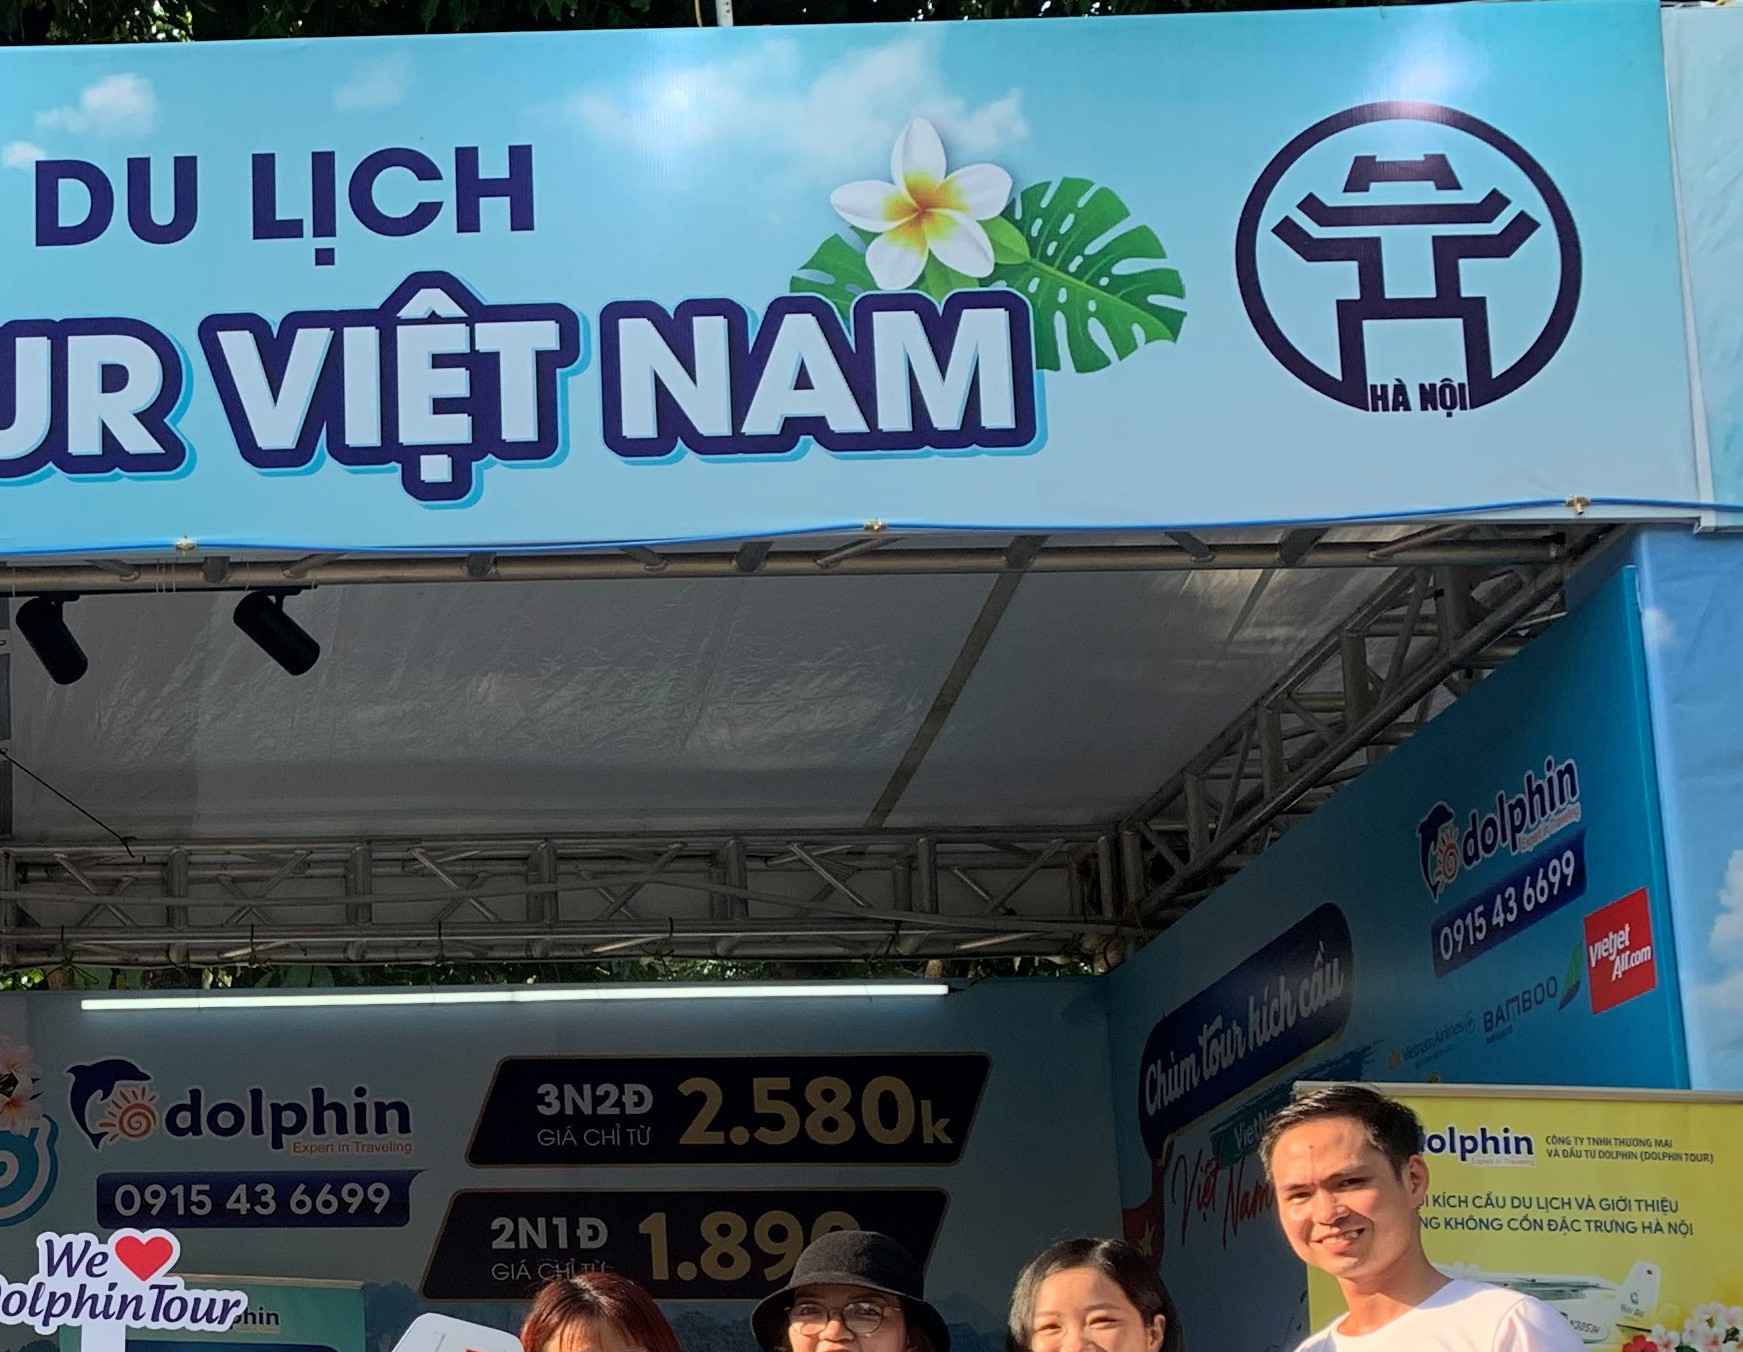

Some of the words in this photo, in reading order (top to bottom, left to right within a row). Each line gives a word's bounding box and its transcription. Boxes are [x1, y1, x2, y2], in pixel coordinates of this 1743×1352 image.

[35, 156, 198, 247] DU
[252, 145, 535, 266] LỊCH
[208, 279, 569, 492] VIỆT
[610, 300, 1025, 446] NAM
[1370, 378, 1412, 414] HÀ
[1420, 380, 1468, 418] NỘI
[1463, 758, 1578, 867] dolphin
[1440, 904, 1487, 960] 0915
[1492, 887, 1518, 928] 43
[1523, 850, 1575, 912] 6699
[1198, 1015, 1246, 1081] tour
[1248, 975, 1297, 1052] kích
[165, 1086, 411, 1150] dolphin
[536, 1083, 654, 1116] 3N2Đ
[677, 1074, 954, 1147] 2.580k
[292, 1141, 335, 1155] Expert
[337, 1142, 349, 1154] in
[355, 1141, 413, 1156] Traveling
[536, 1125, 578, 1148] GIÁ
[583, 1122, 621, 1147] CHỈ
[624, 1124, 652, 1147] TỪ
[1421, 1126, 1534, 1161] olphin
[1546, 1134, 1571, 1146] CÔNG
[1574, 1136, 1584, 1146] TY
[1587, 1136, 1612, 1147] TNHH
[1598, 1150, 1638, 1160] DOLPHIN
[1640, 1151, 1683, 1163] (DOLPHIN
[1684, 1153, 1715, 1164] TOUR)
[115, 1184, 212, 1217] 0915
[226, 1183, 276, 1216] 43
[290, 1182, 391, 1215] 6699
[1432, 1193, 1469, 1209] KÍCH
[1472, 1191, 1506, 1209] CẦU
[1510, 1196, 1532, 1209] DU
[1536, 1197, 1571, 1213] LỊCH
[1575, 1194, 1596, 1211] VÀ
[490, 1216, 609, 1250] 2N1Đ
[1444, 1214, 1504, 1231] KHÔNG
[1585, 1218, 1638, 1235] TRƯNG
[1642, 1218, 1665, 1235] HÀ
[1668, 1218, 1694, 1239] NỘI
[44, 1238, 109, 1278] We
[491, 1261, 532, 1282] GIÁ
